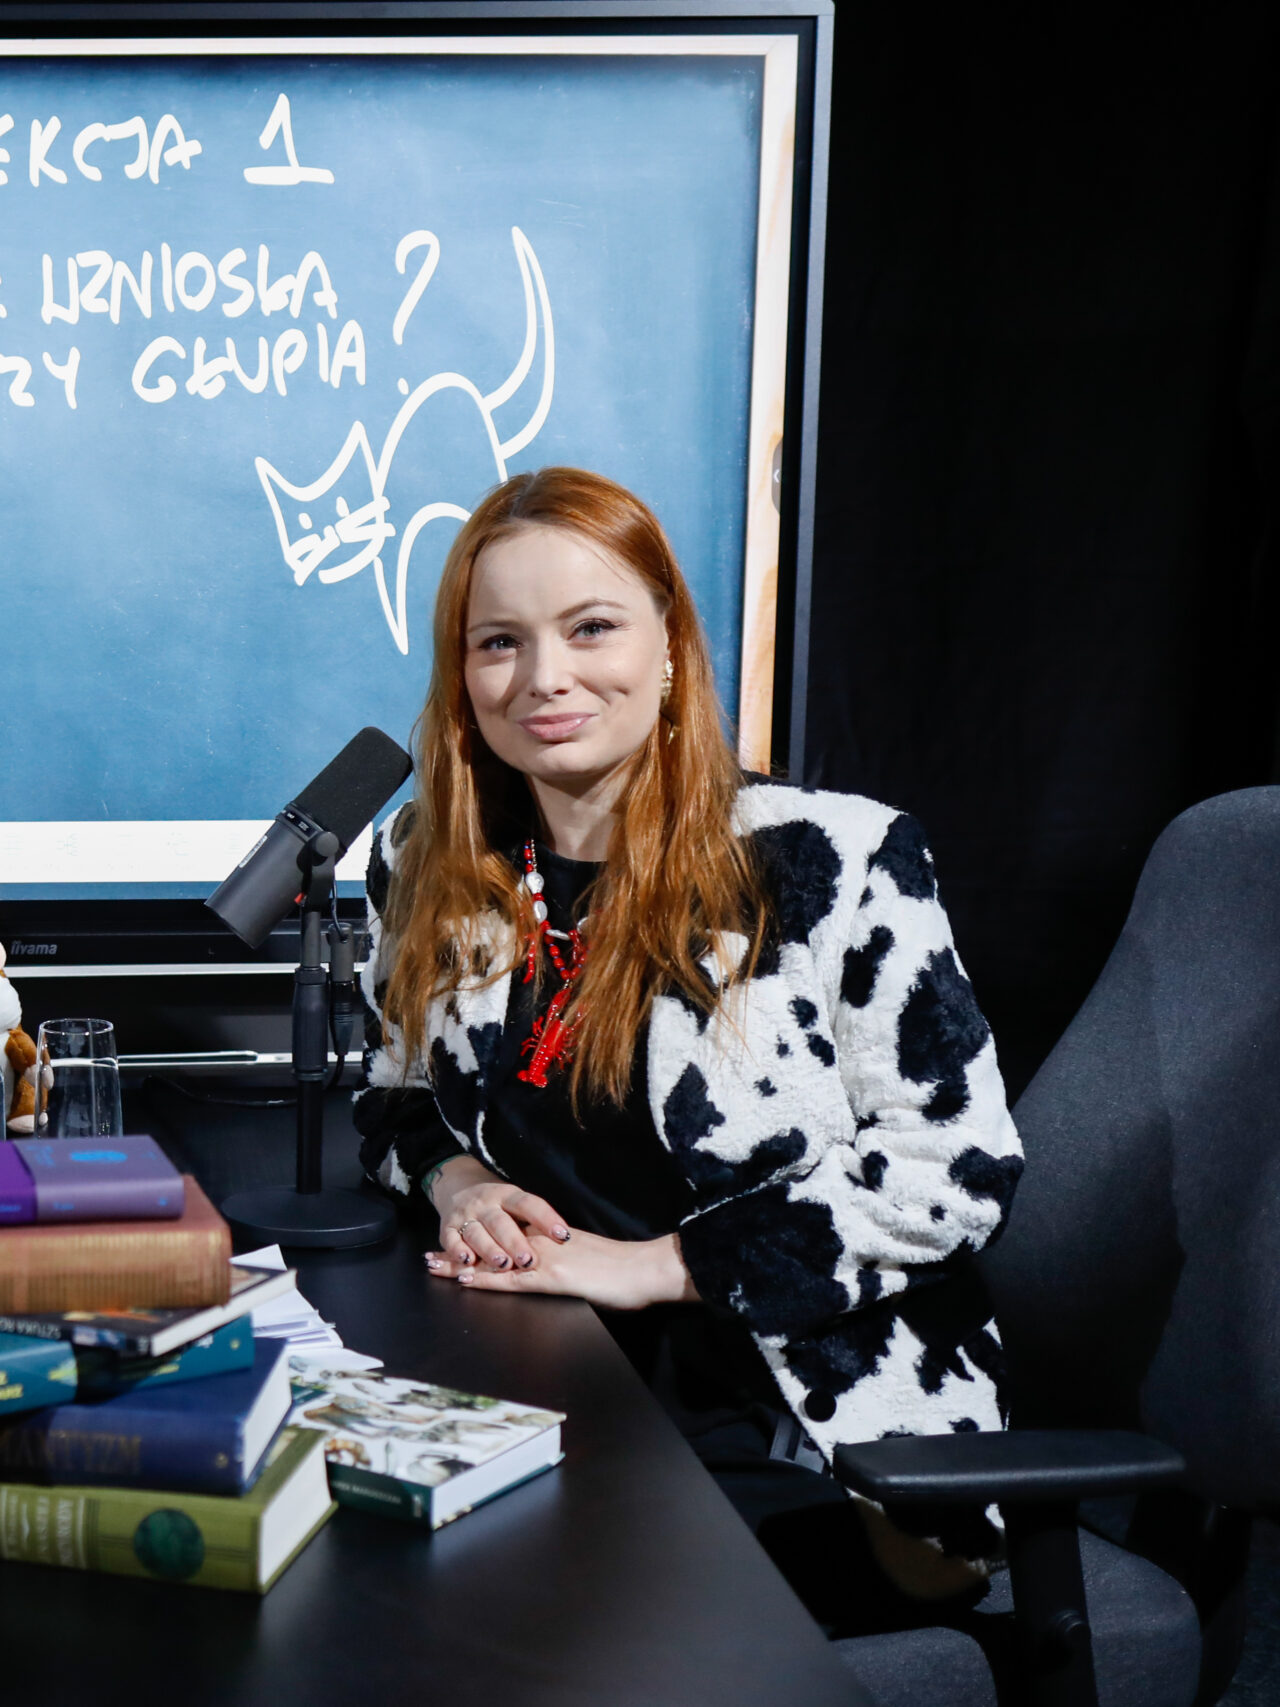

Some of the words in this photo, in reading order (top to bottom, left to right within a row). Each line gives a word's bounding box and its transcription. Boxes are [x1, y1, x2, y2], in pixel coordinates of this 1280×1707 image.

[243, 93, 335, 186] 1
[131, 319, 366, 403] GŁUPIA
[10, 940, 58, 955] iiyama
